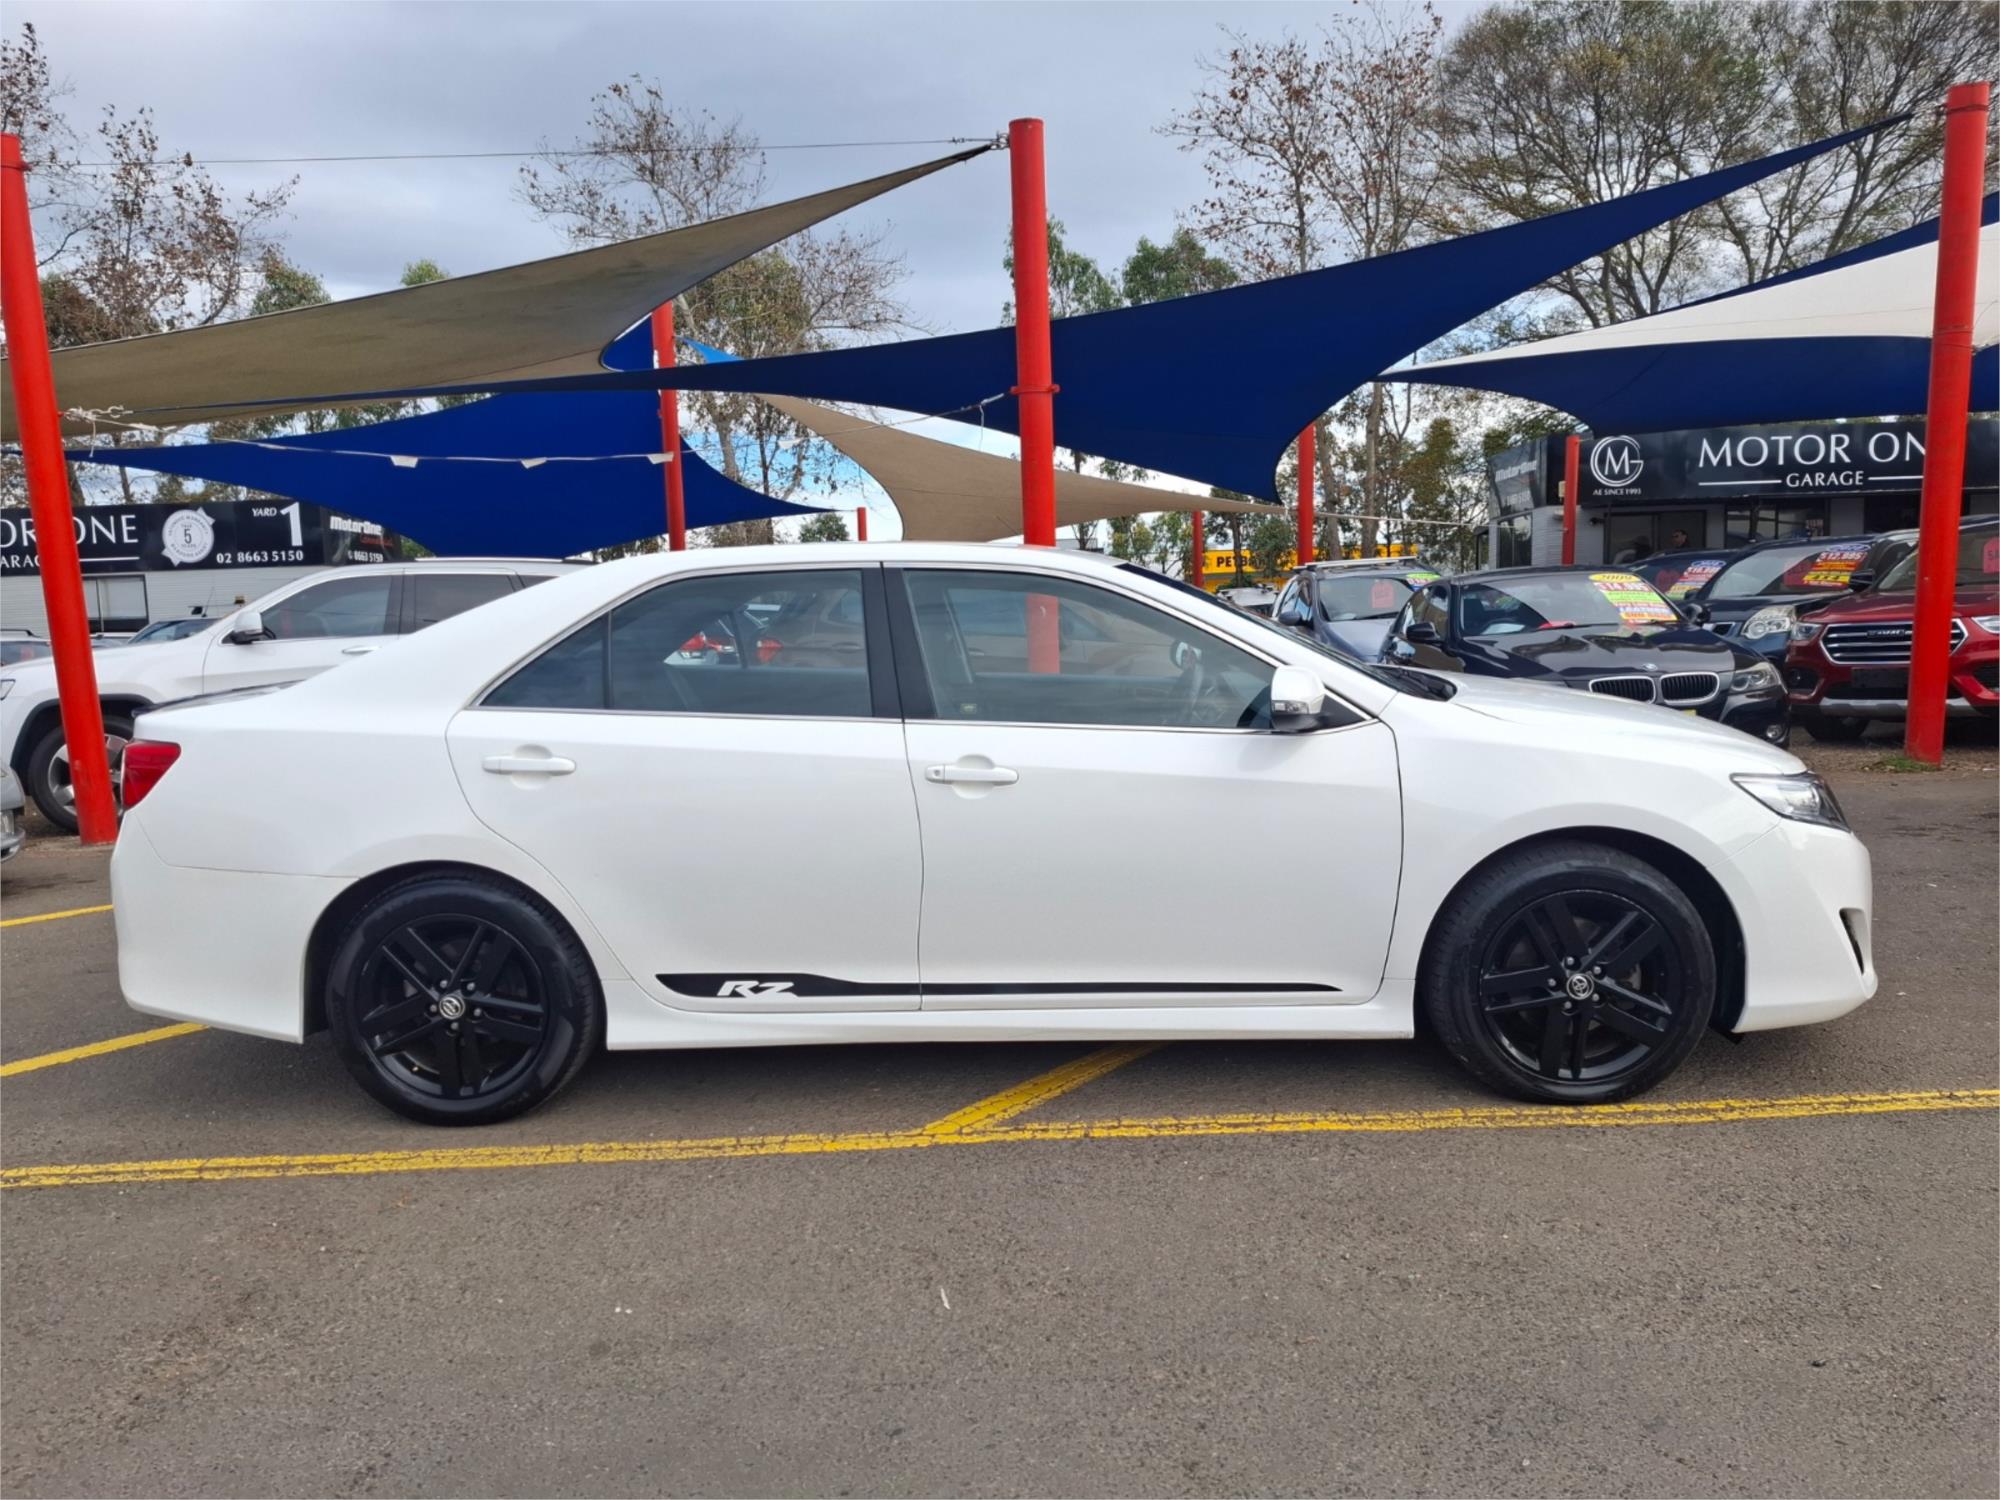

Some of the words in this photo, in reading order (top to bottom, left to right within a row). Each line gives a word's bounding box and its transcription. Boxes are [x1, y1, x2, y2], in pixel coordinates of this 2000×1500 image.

[1698, 434, 1852, 468] MOTOR
[1868, 431, 1926, 463] ON
[1786, 471, 1864, 488] GARAGE
[252, 507, 277, 517] YARD
[280, 501, 303, 546] 1
[184, 528, 192, 544] 5
[216, 552, 232, 564] 02
[237, 551, 269, 563] 8663
[271, 550, 304, 562] 5150
[716, 980, 800, 998] RZ
